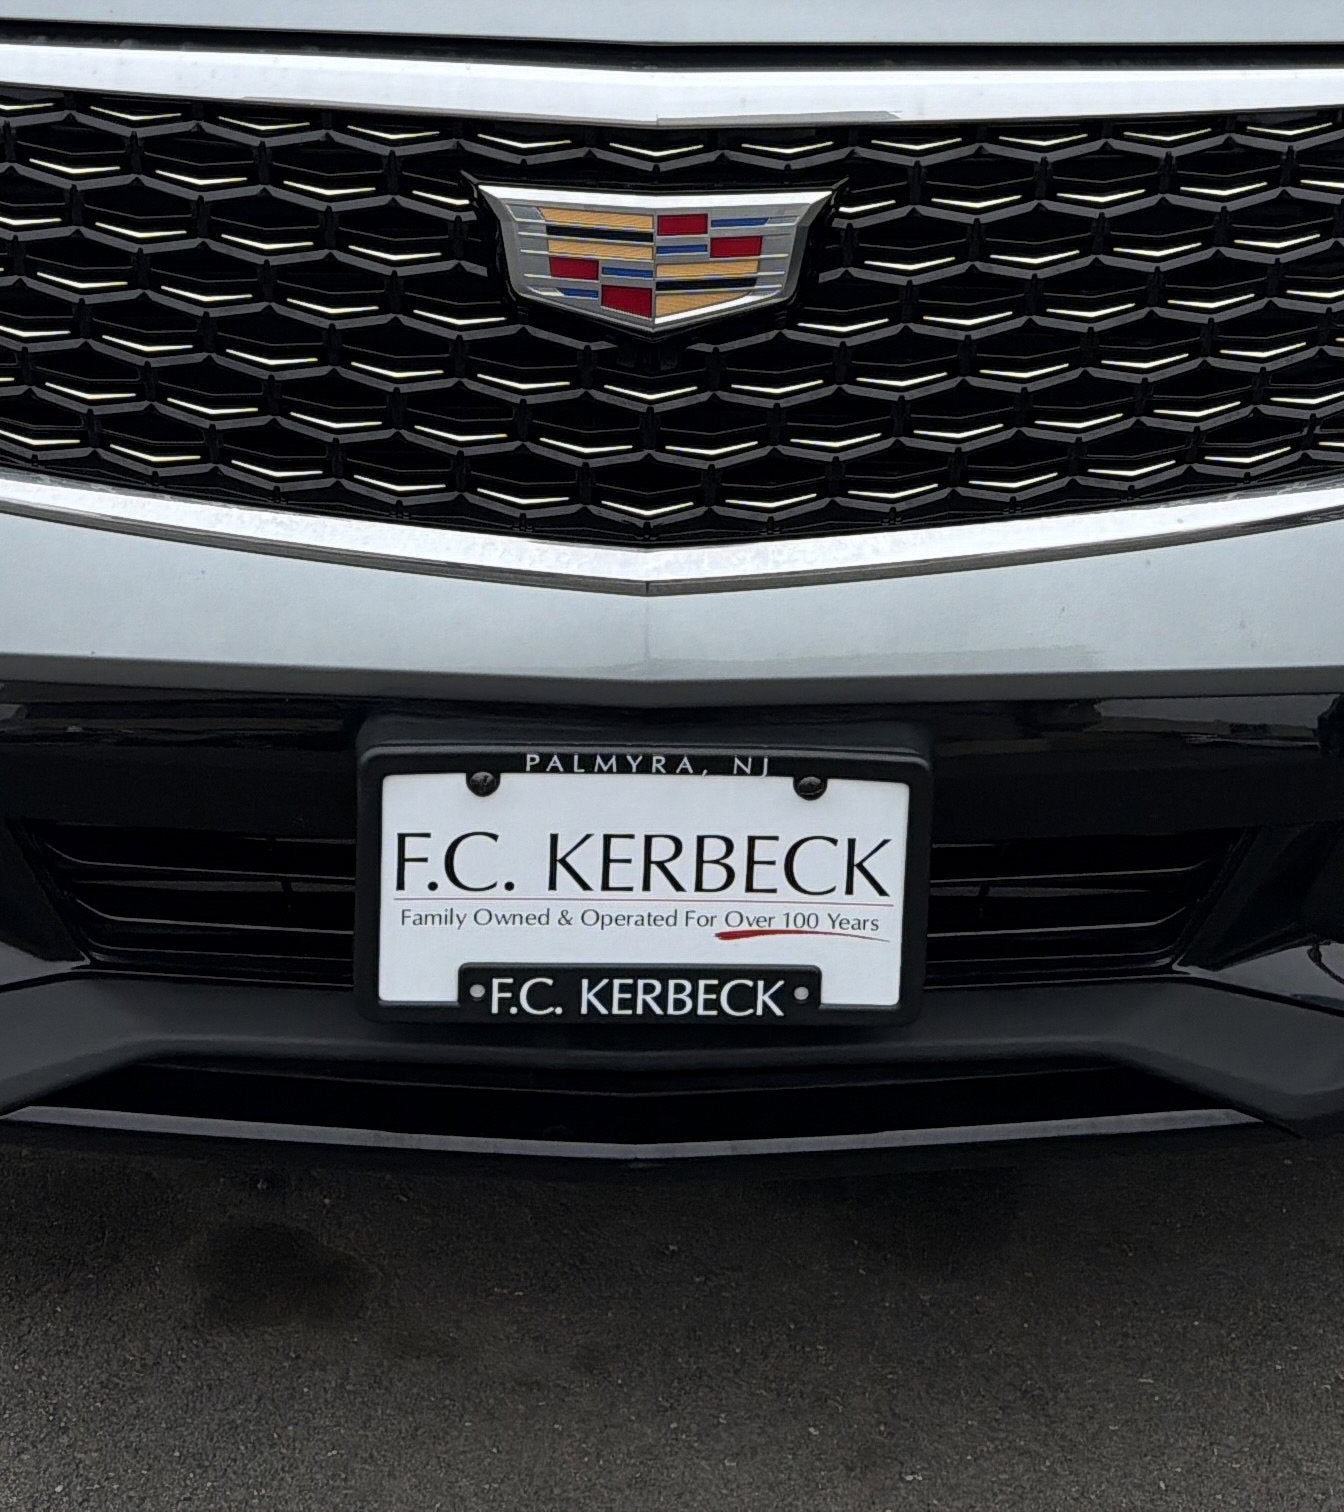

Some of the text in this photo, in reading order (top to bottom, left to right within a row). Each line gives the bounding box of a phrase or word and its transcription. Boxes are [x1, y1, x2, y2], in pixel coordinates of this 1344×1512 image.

[525, 754, 769, 777] PALMYRA, NJ
[396, 831, 892, 897] F.C. KERBECK
[401, 908, 879, 932] Family Owned & Operated For Over 100 Years
[491, 977, 785, 1017] F.C. KERBECK
